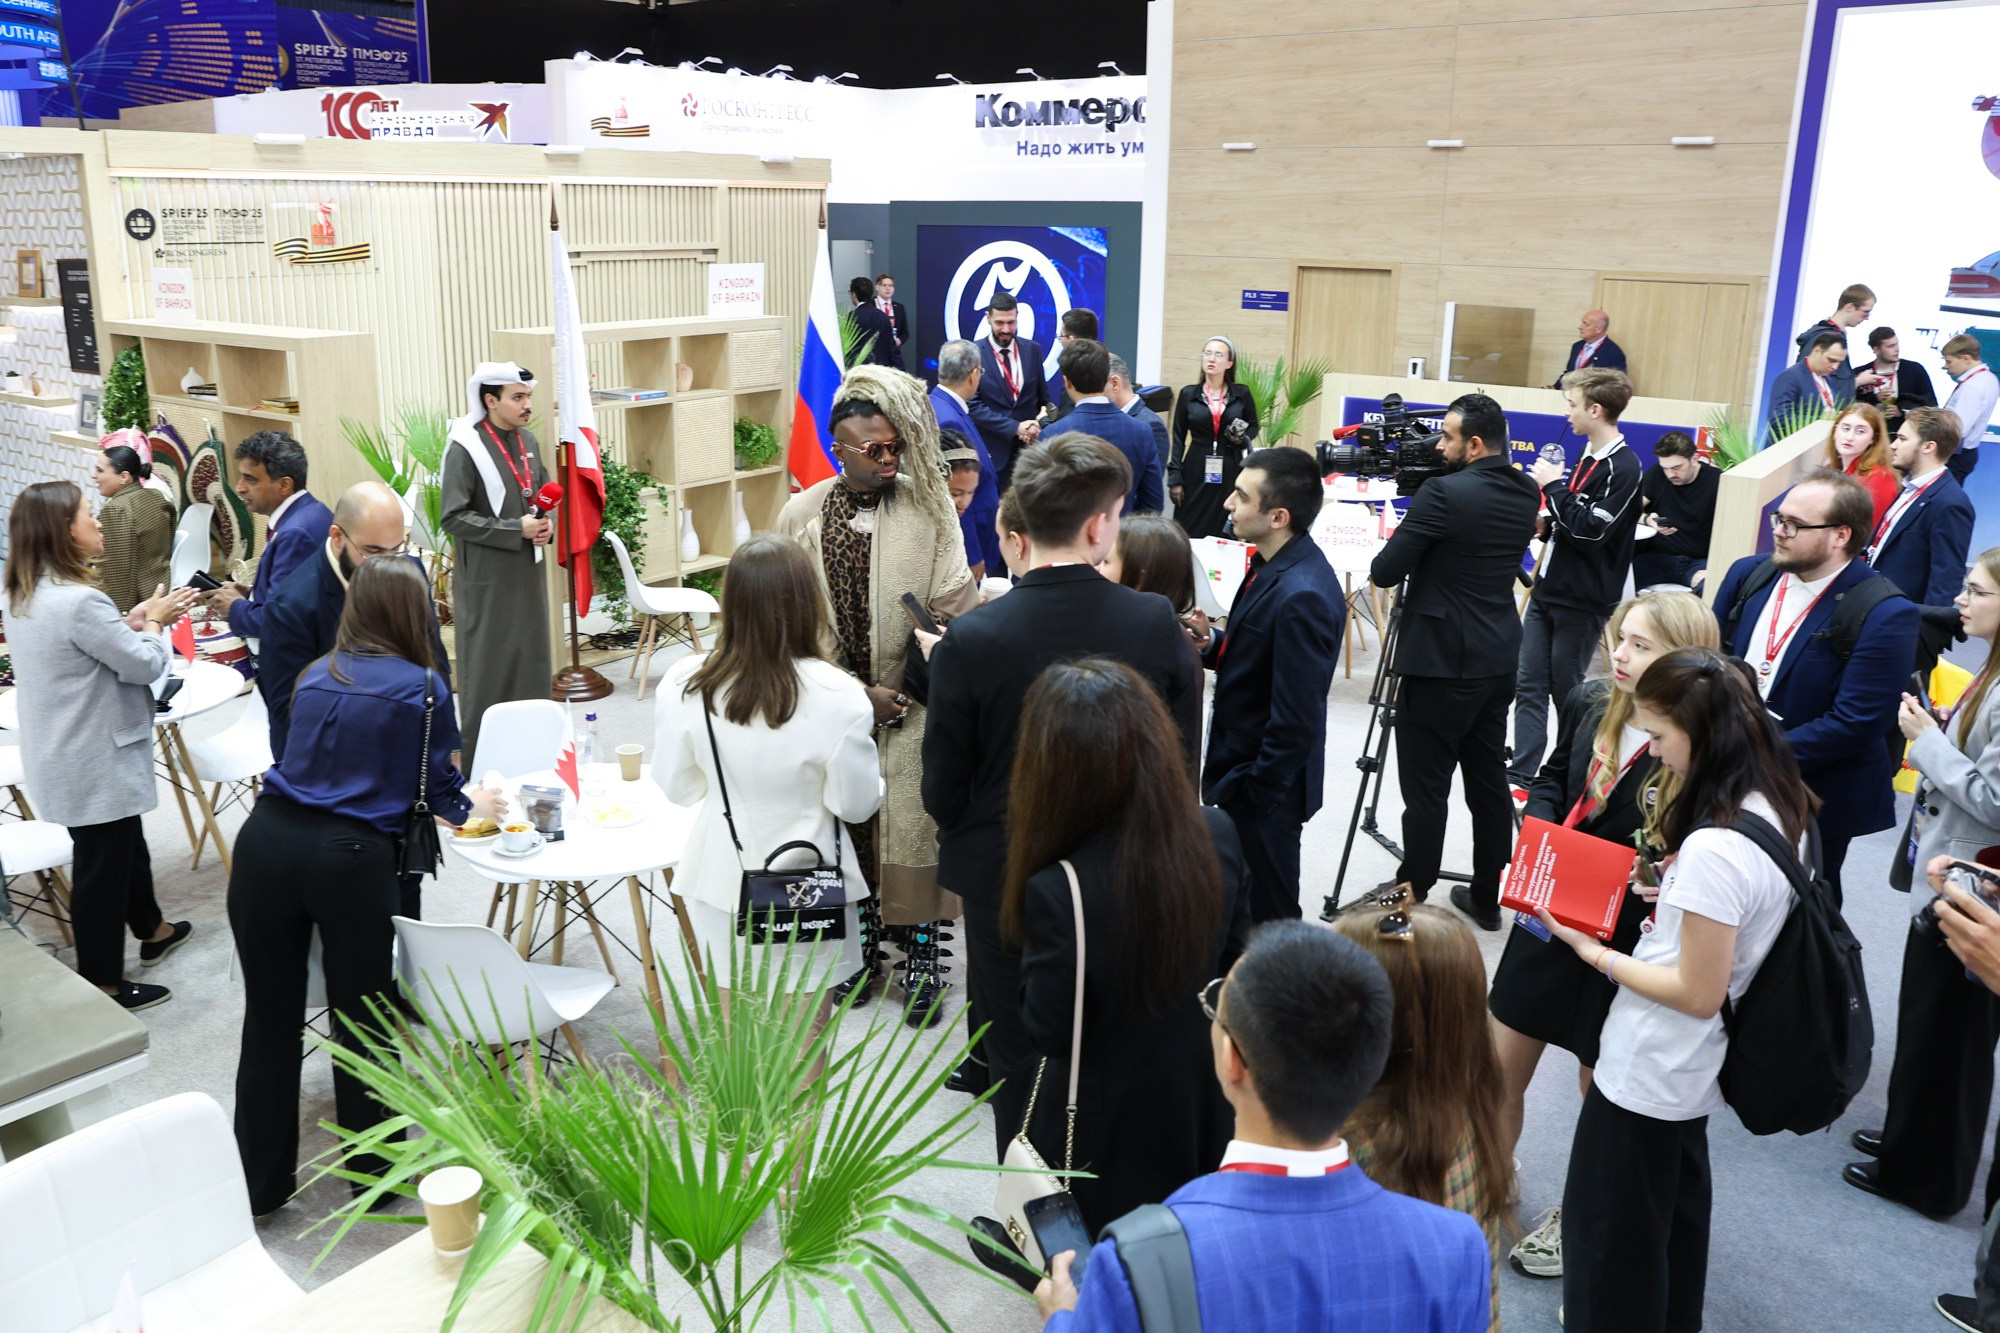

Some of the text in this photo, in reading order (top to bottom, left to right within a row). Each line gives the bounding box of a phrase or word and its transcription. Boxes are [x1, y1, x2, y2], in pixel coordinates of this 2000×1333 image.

[294, 43, 347, 58] SPIEF'25
[353, 47, 408, 63] ПМЭФ'25
[370, 101, 399, 112] ЛЕТ
[371, 127, 434, 137] ПРАВДА
[1017, 141, 1062, 157] Надо
[1068, 143, 1115, 155] жить
[161, 208, 208, 218] SPIEF'25
[214, 208, 262, 218] ПМЭФ'25
[1326, 525, 1367, 535] KINGDOM
[1331, 537, 1374, 548] BAHRAIN
[812, 870, 837, 879] TURN
[819, 878, 843, 890] OPEN
